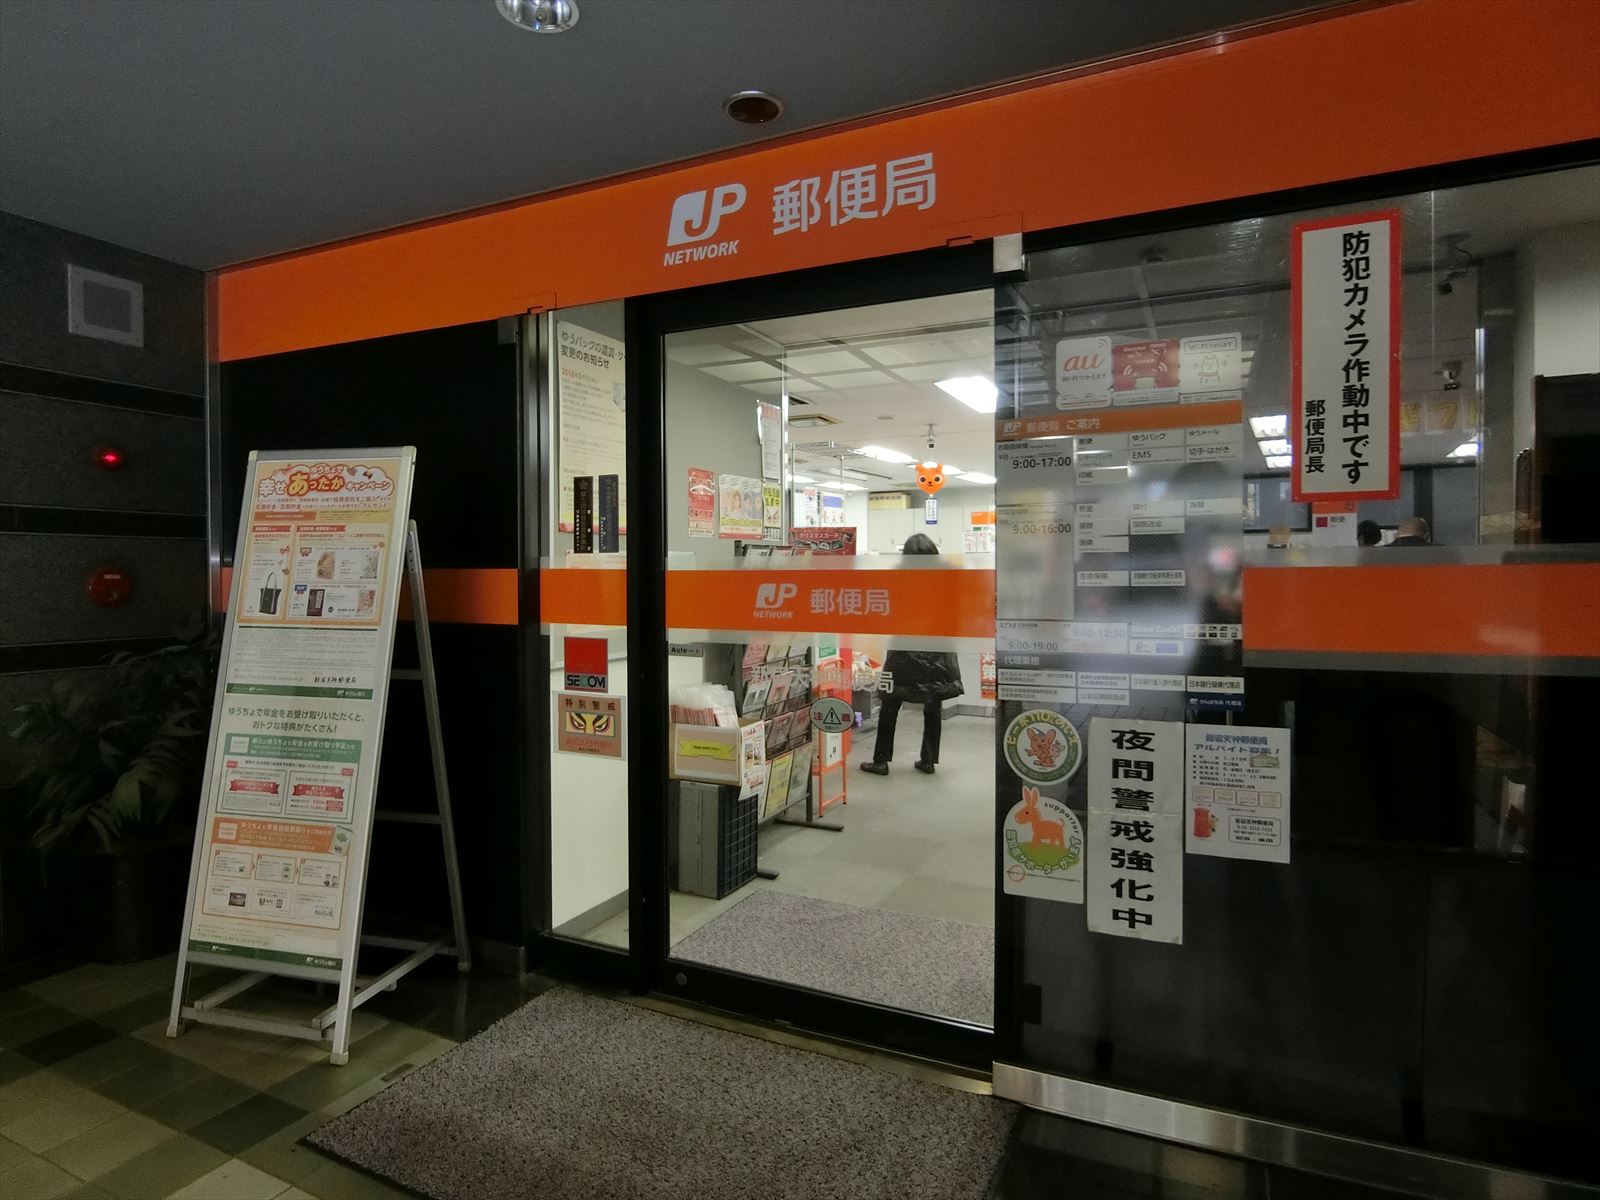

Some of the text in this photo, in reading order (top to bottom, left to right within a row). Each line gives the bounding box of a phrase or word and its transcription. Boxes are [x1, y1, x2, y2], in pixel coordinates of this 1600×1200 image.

[772, 152, 937, 236] 郵便局
[663, 240, 740, 266] NETWORK
[561, 344, 610, 369] 変更のお知らせ
[1062, 352, 1104, 372] au
[1342, 230, 1371, 485] 防犯カメラ作動中です
[1066, 417, 1100, 430] ご案内
[1132, 432, 1166, 441] ゆうパック
[1305, 399, 1325, 474] 郵便局長
[1013, 456, 1072, 469] 9:00-17:00
[1132, 450, 1151, 459] EMS
[799, 532, 840, 540] クリスマスカード
[1013, 523, 1072, 535] 9:00-16:00
[810, 588, 891, 616] 郵便局
[753, 610, 794, 619] NETWORK
[1008, 641, 1058, 651] 9:00-19:00
[228, 706, 365, 723] ゆうちょで年金をお受け取りいただくと、
[1044, 801, 1080, 835] supporter
[1110, 729, 1156, 929] 夜間警戒強化中
